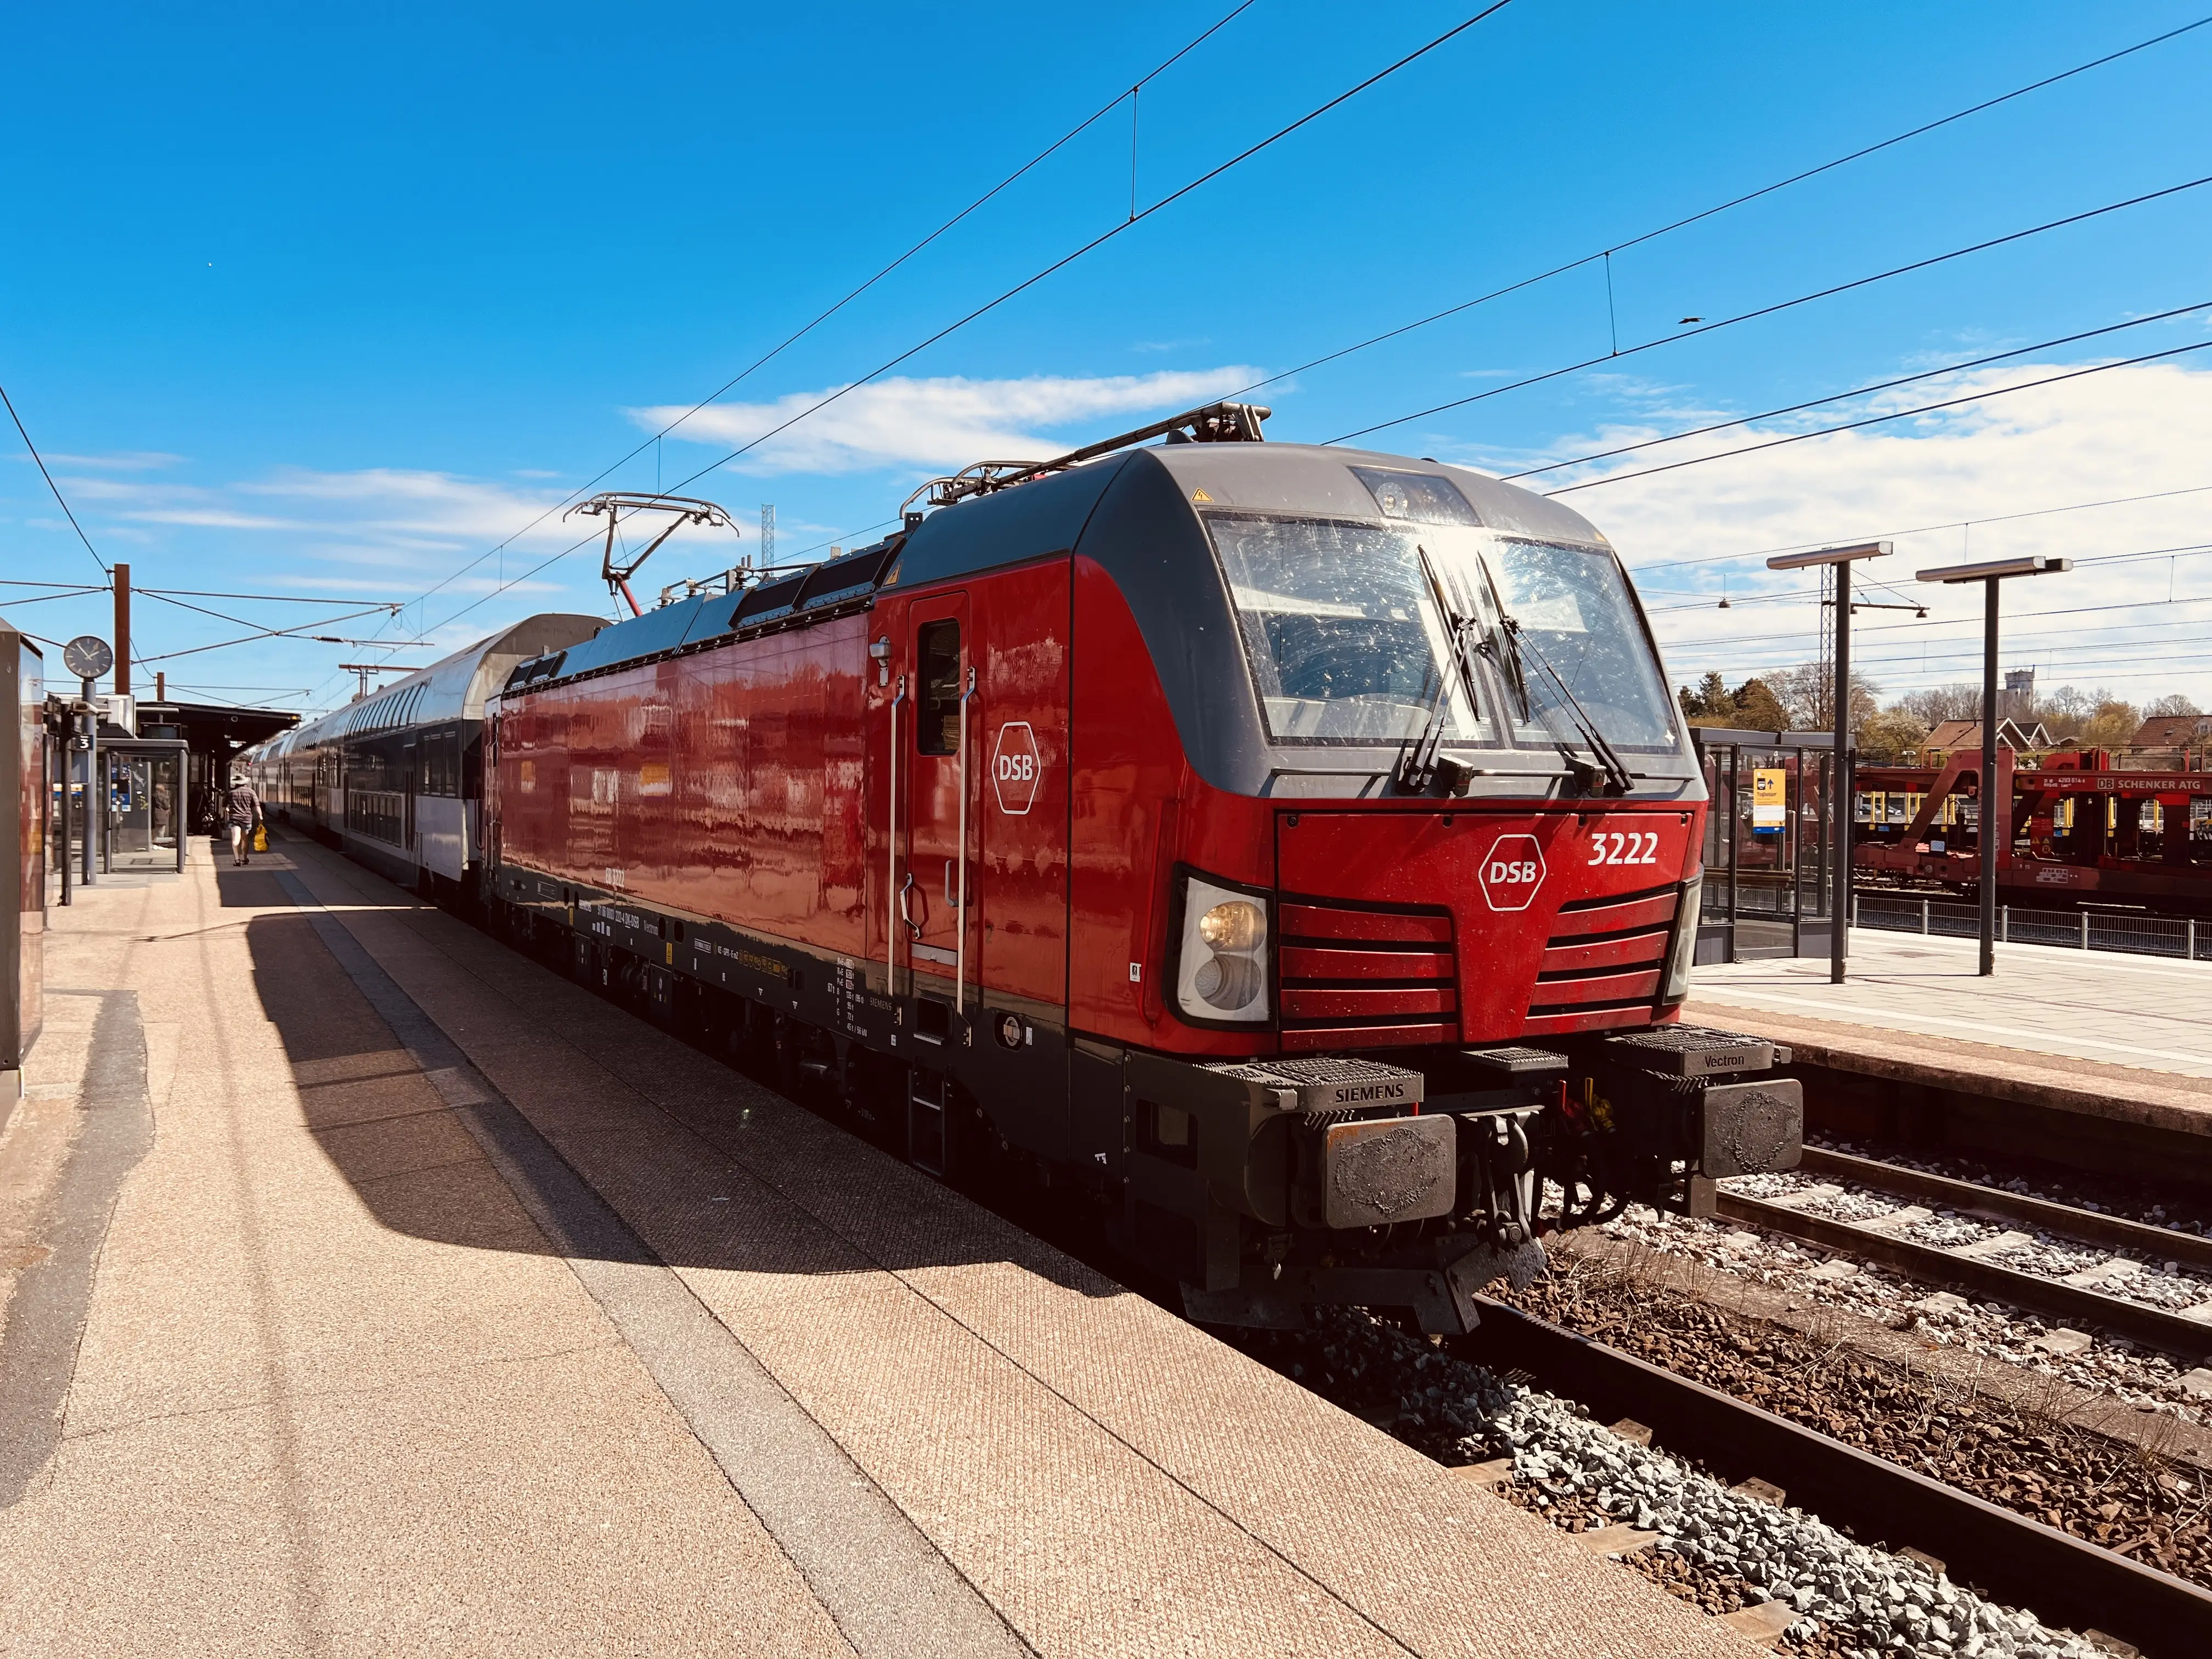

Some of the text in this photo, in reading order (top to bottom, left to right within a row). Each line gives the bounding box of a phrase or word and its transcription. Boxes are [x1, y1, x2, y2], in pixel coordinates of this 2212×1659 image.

[80, 738, 89, 749] 3
[1000, 755, 1032, 780] DSB
[2098, 779, 2200, 789] DB SCHENKER ATG
[1588, 832, 1658, 866] 3222
[1489, 861, 1536, 883] DSB
[870, 997, 892, 1011] SIEMENS
[1705, 1056, 1744, 1068] Vectron
[1336, 1084, 1404, 1103] SIEMENS
